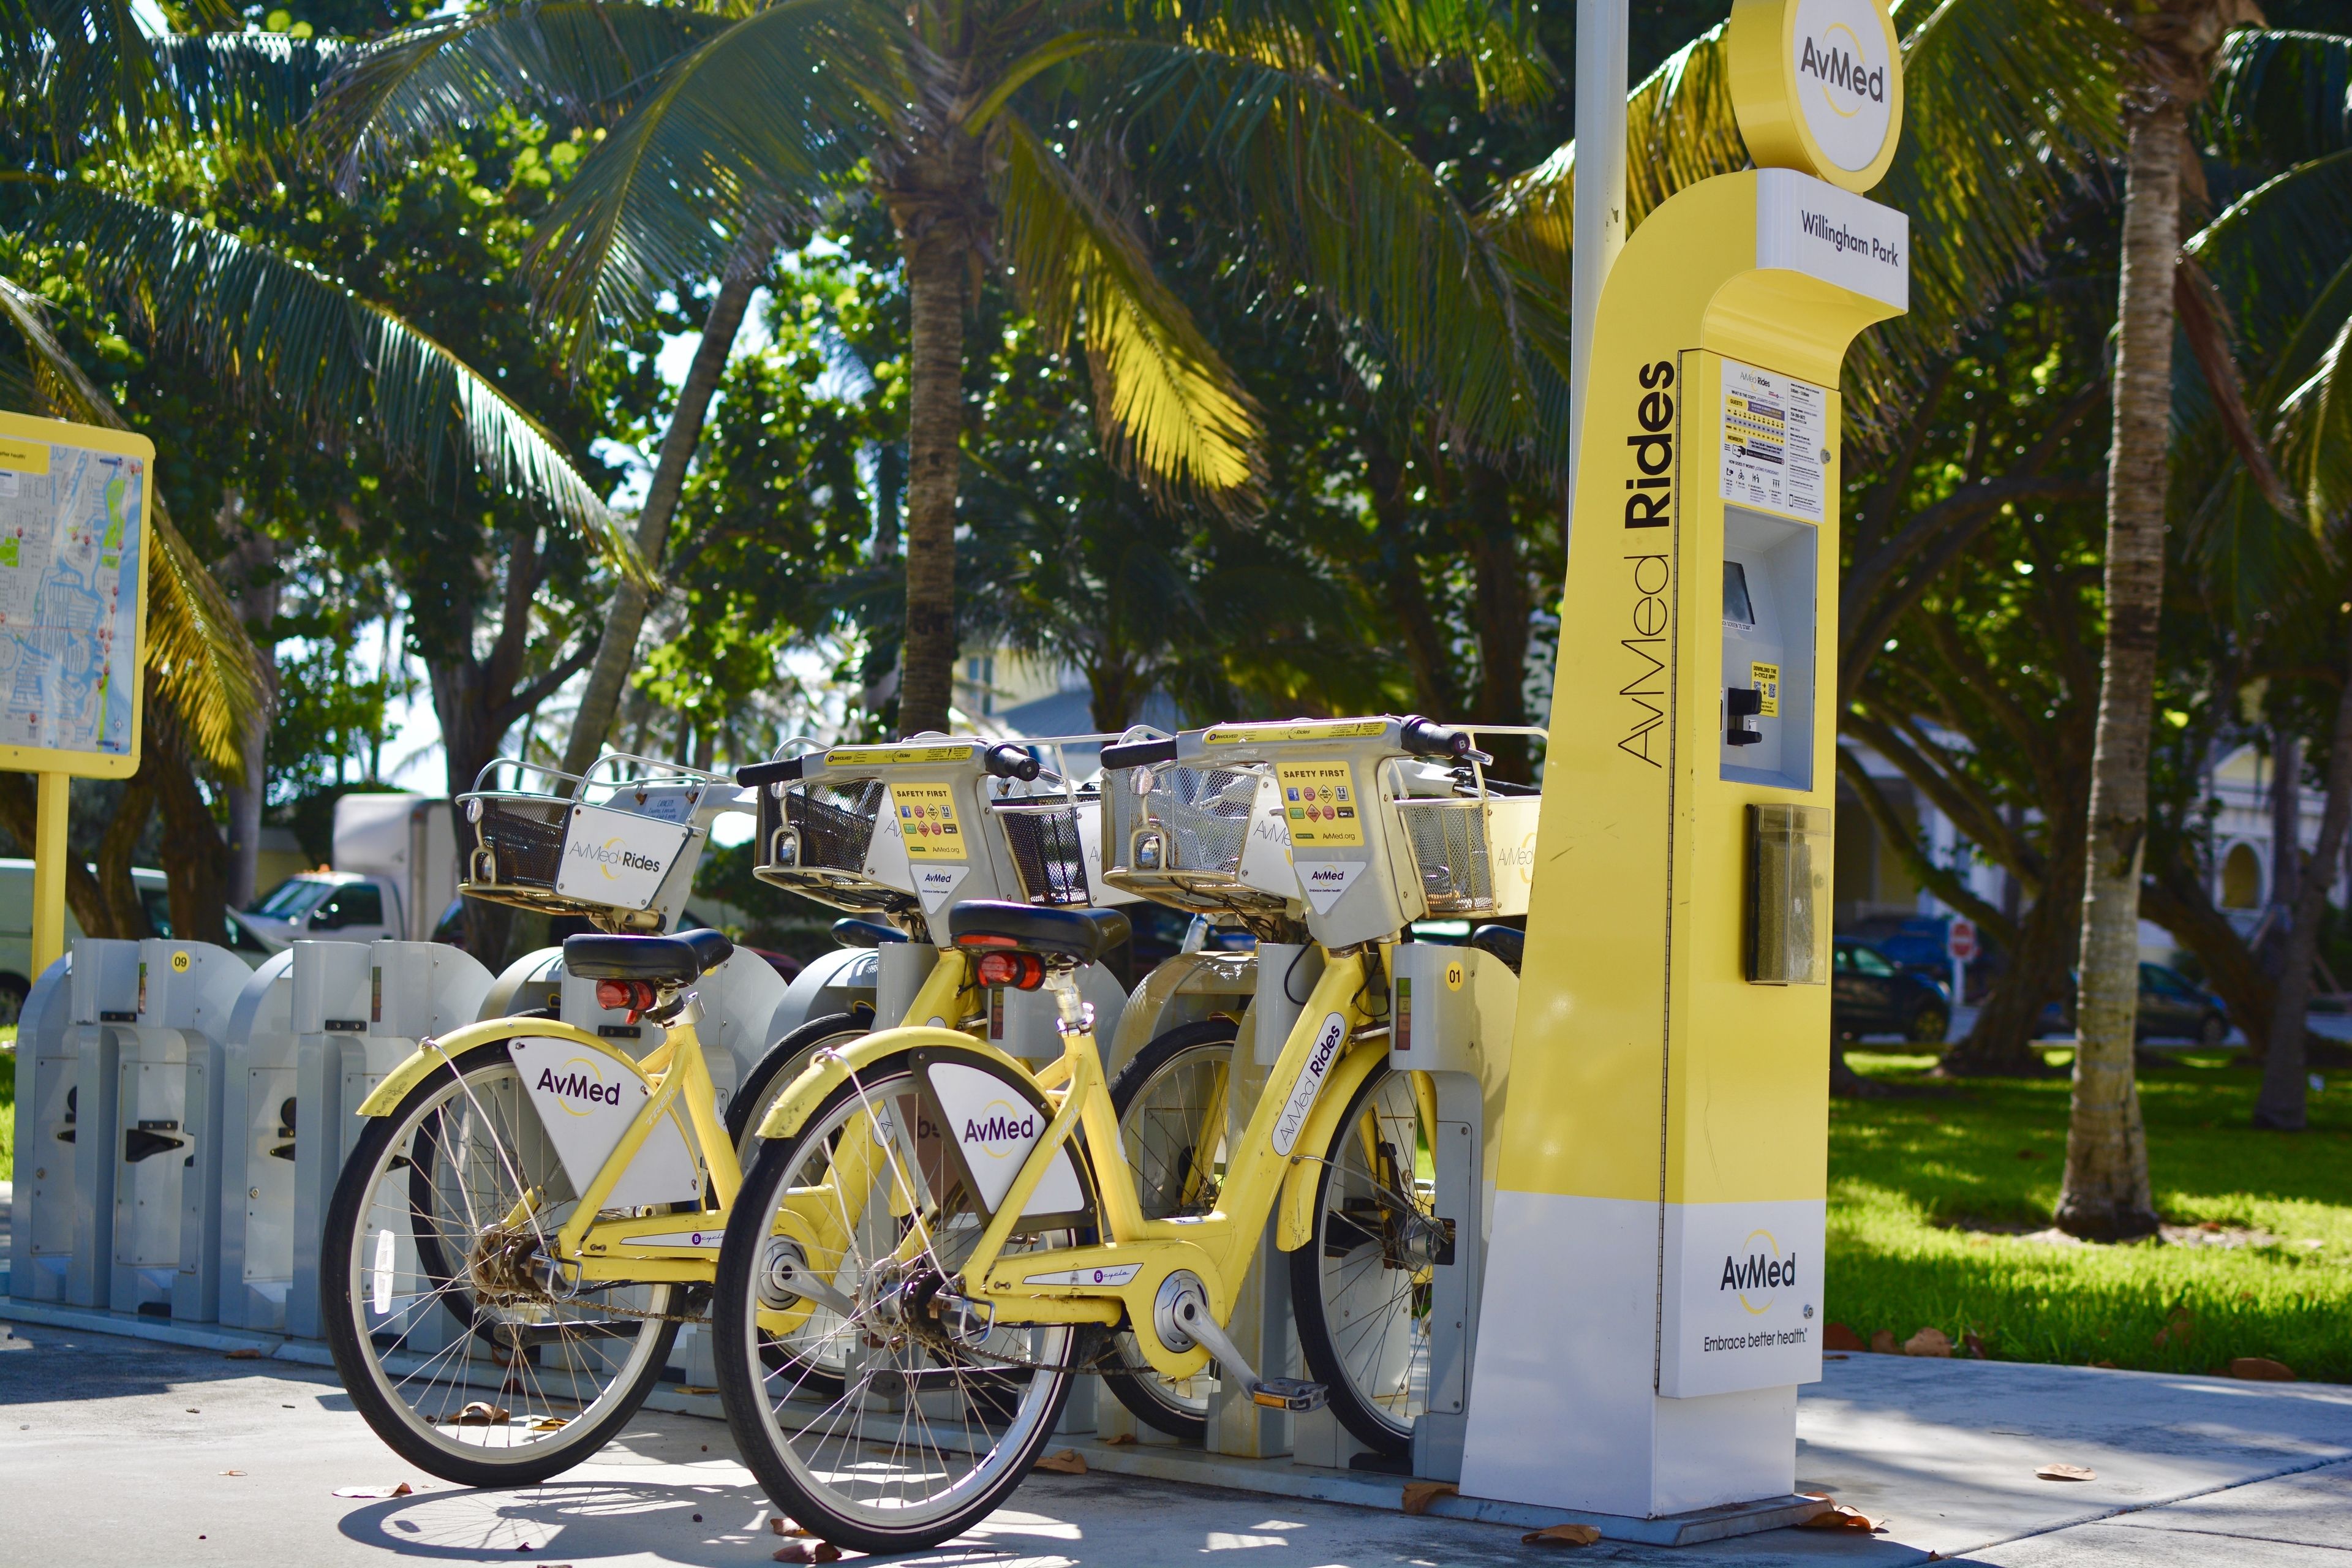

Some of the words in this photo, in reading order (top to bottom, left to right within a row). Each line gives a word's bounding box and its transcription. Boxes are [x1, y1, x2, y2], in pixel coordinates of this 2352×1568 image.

[1801, 37, 1883, 103] AvMed
[1801, 210, 1868, 255] Willingham
[1873, 238, 1898, 267] Park
[1757, 377, 1770, 387] Rides
[1625, 363, 1675, 529] Rides
[1728, 435, 1744, 443] MEMBERS
[1618, 554, 1669, 769] AvMed
[1458, 739, 1466, 749] B
[1253, 820, 1291, 846] AvMe
[1322, 832, 1355, 841] AvMed.org
[569, 841, 620, 864] AvMed
[622, 851, 660, 873] Rides
[1497, 846, 1534, 867] AvMed
[925, 873, 951, 883] AvMed
[1311, 871, 1344, 880] AvMed
[175, 956, 187, 967] 09
[1449, 969, 1460, 983] 01
[537, 1068, 620, 1106] AvMed
[1280, 1076, 1315, 1147] AvMed
[1310, 1025, 1340, 1078] Rides
[646, 1085, 675, 1125] TREK
[963, 1114, 1033, 1143] AvMed
[1720, 1253, 1795, 1291] AvMed
[1705, 1335, 1746, 1352] Embrace
[1748, 1332, 1776, 1348] better
